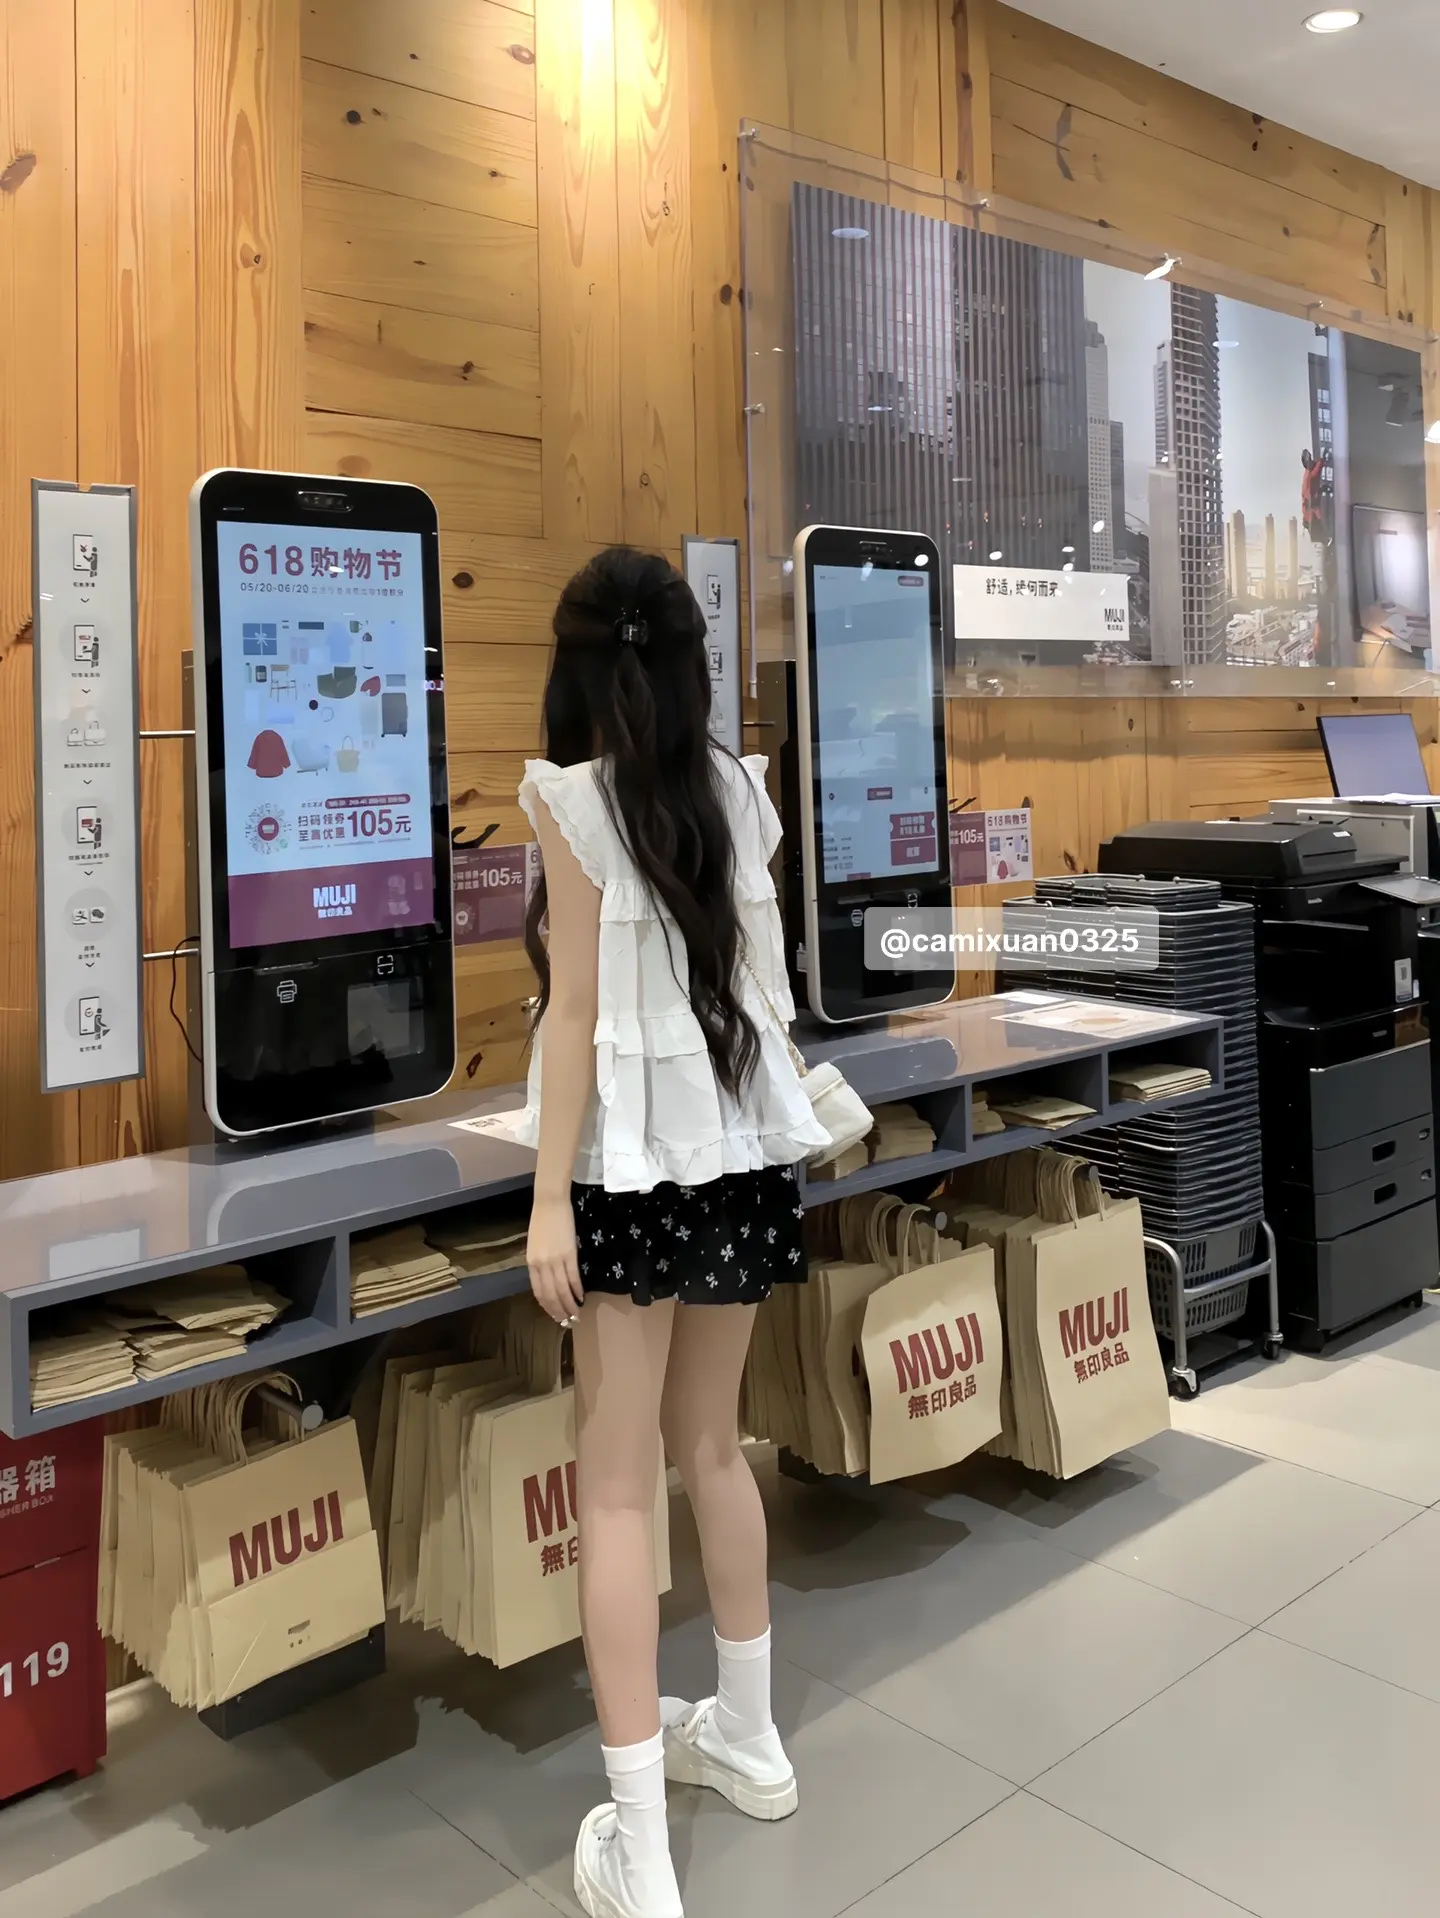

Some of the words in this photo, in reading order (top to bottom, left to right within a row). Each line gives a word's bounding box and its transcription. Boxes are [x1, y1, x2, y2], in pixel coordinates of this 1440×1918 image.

[239, 543, 402, 580] 618购物节
[240, 582, 309, 594] 05/20-06/20
[347, 809, 412, 838] 105元
[312, 883, 357, 908] MUJI
[480, 867, 523, 888] 105元
[1058, 1286, 1130, 1359] MUJI
[888, 1312, 984, 1395] MUJI
[1073, 1341, 1130, 1384] 無印良品
[907, 1373, 977, 1420] 無印良品
[228, 1489, 344, 1588] MUJI
[0, 1641, 70, 1698] 119
